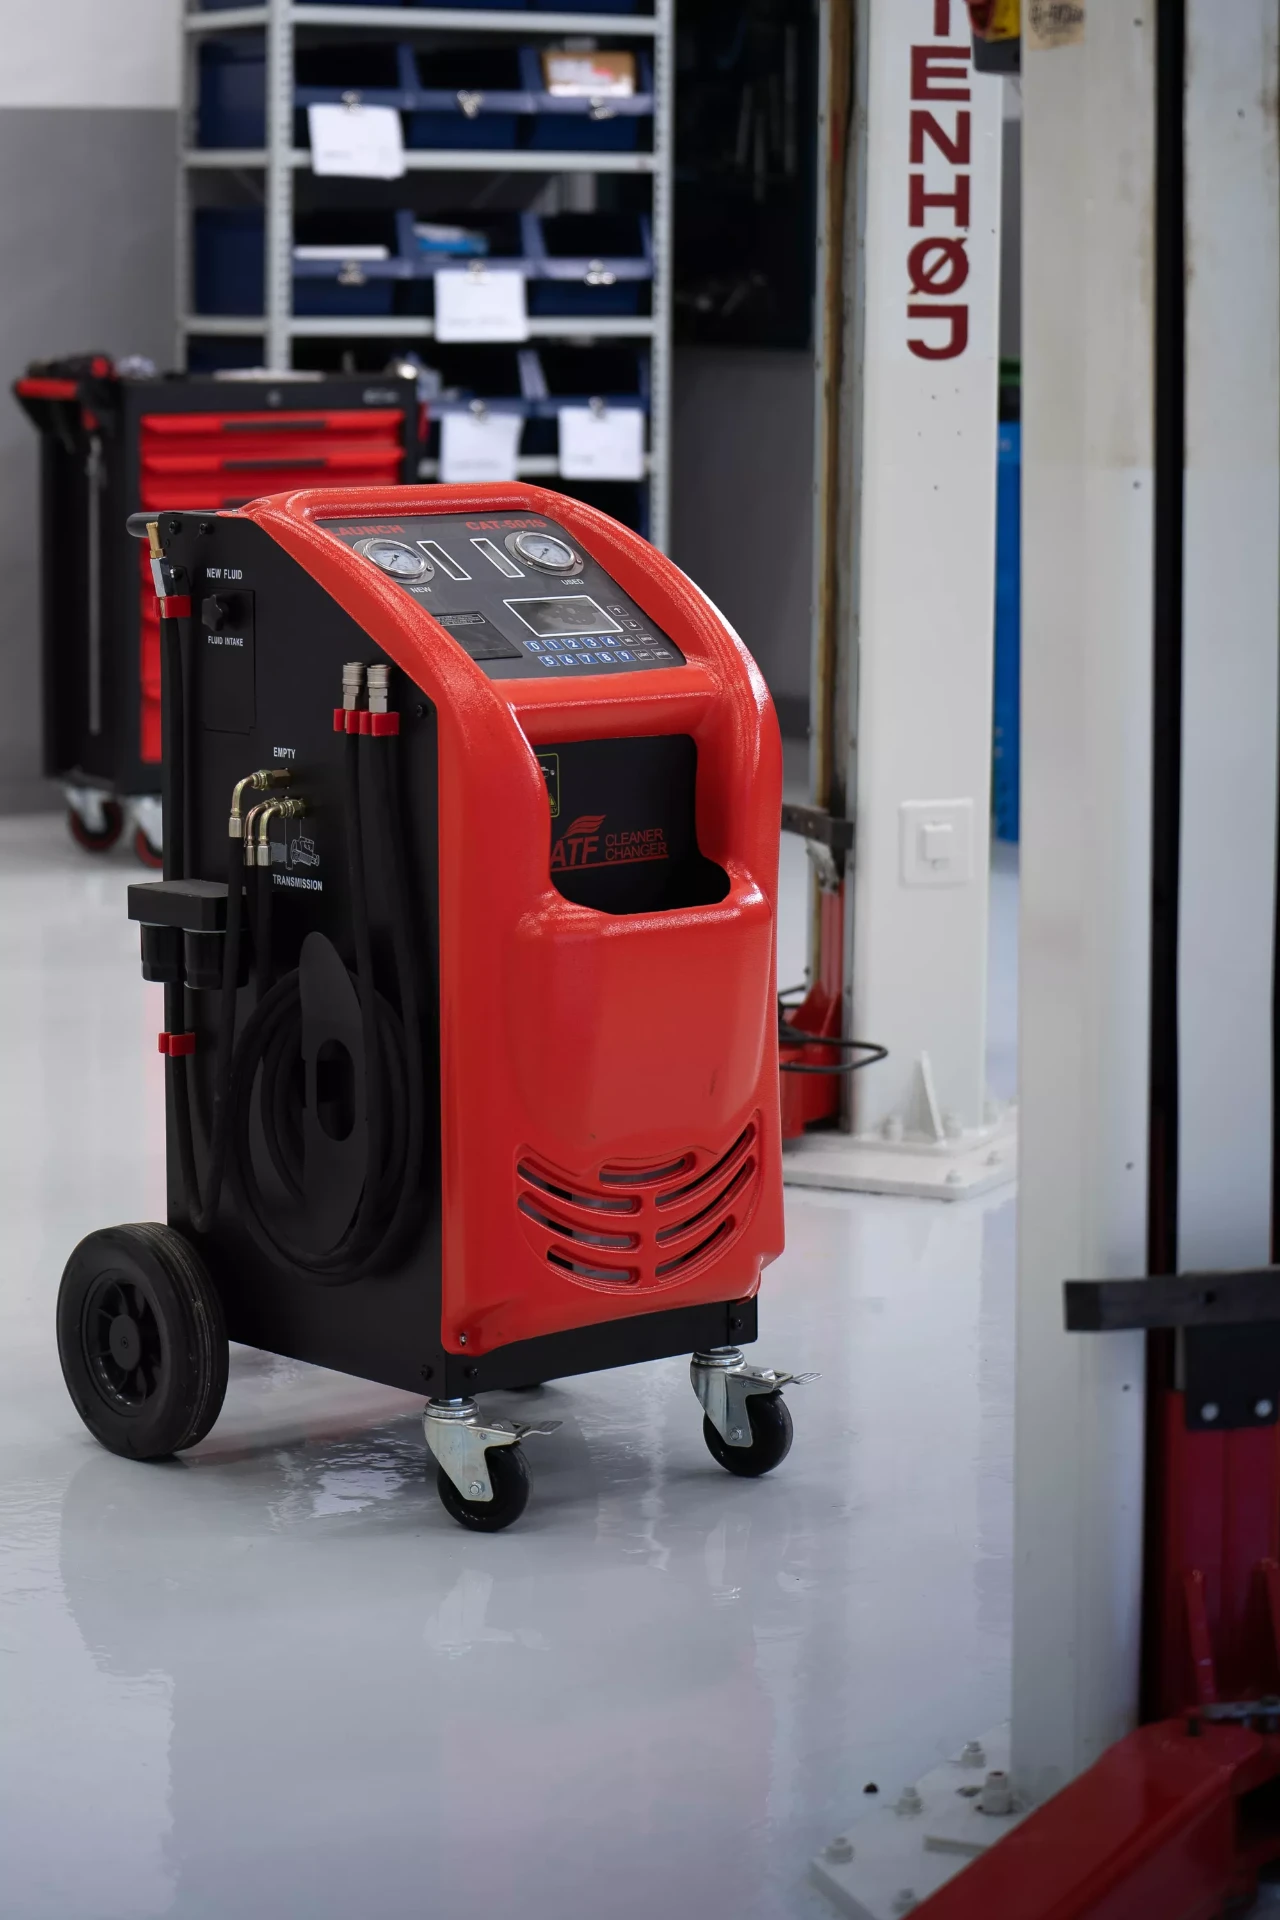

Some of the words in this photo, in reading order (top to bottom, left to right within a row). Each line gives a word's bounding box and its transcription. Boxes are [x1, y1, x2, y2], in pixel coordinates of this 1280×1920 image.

[206, 568, 221, 578] NEW
[223, 569, 243, 580] FLUID
[207, 635, 223, 645] FLUID
[224, 637, 244, 647] INTAKE
[273, 747, 296, 760] EMPTY
[605, 829, 663, 846] CLEANER
[551, 836, 599, 867] ATF
[605, 843, 667, 860] CHANGER
[272, 873, 323, 892] TRANSMISSION
